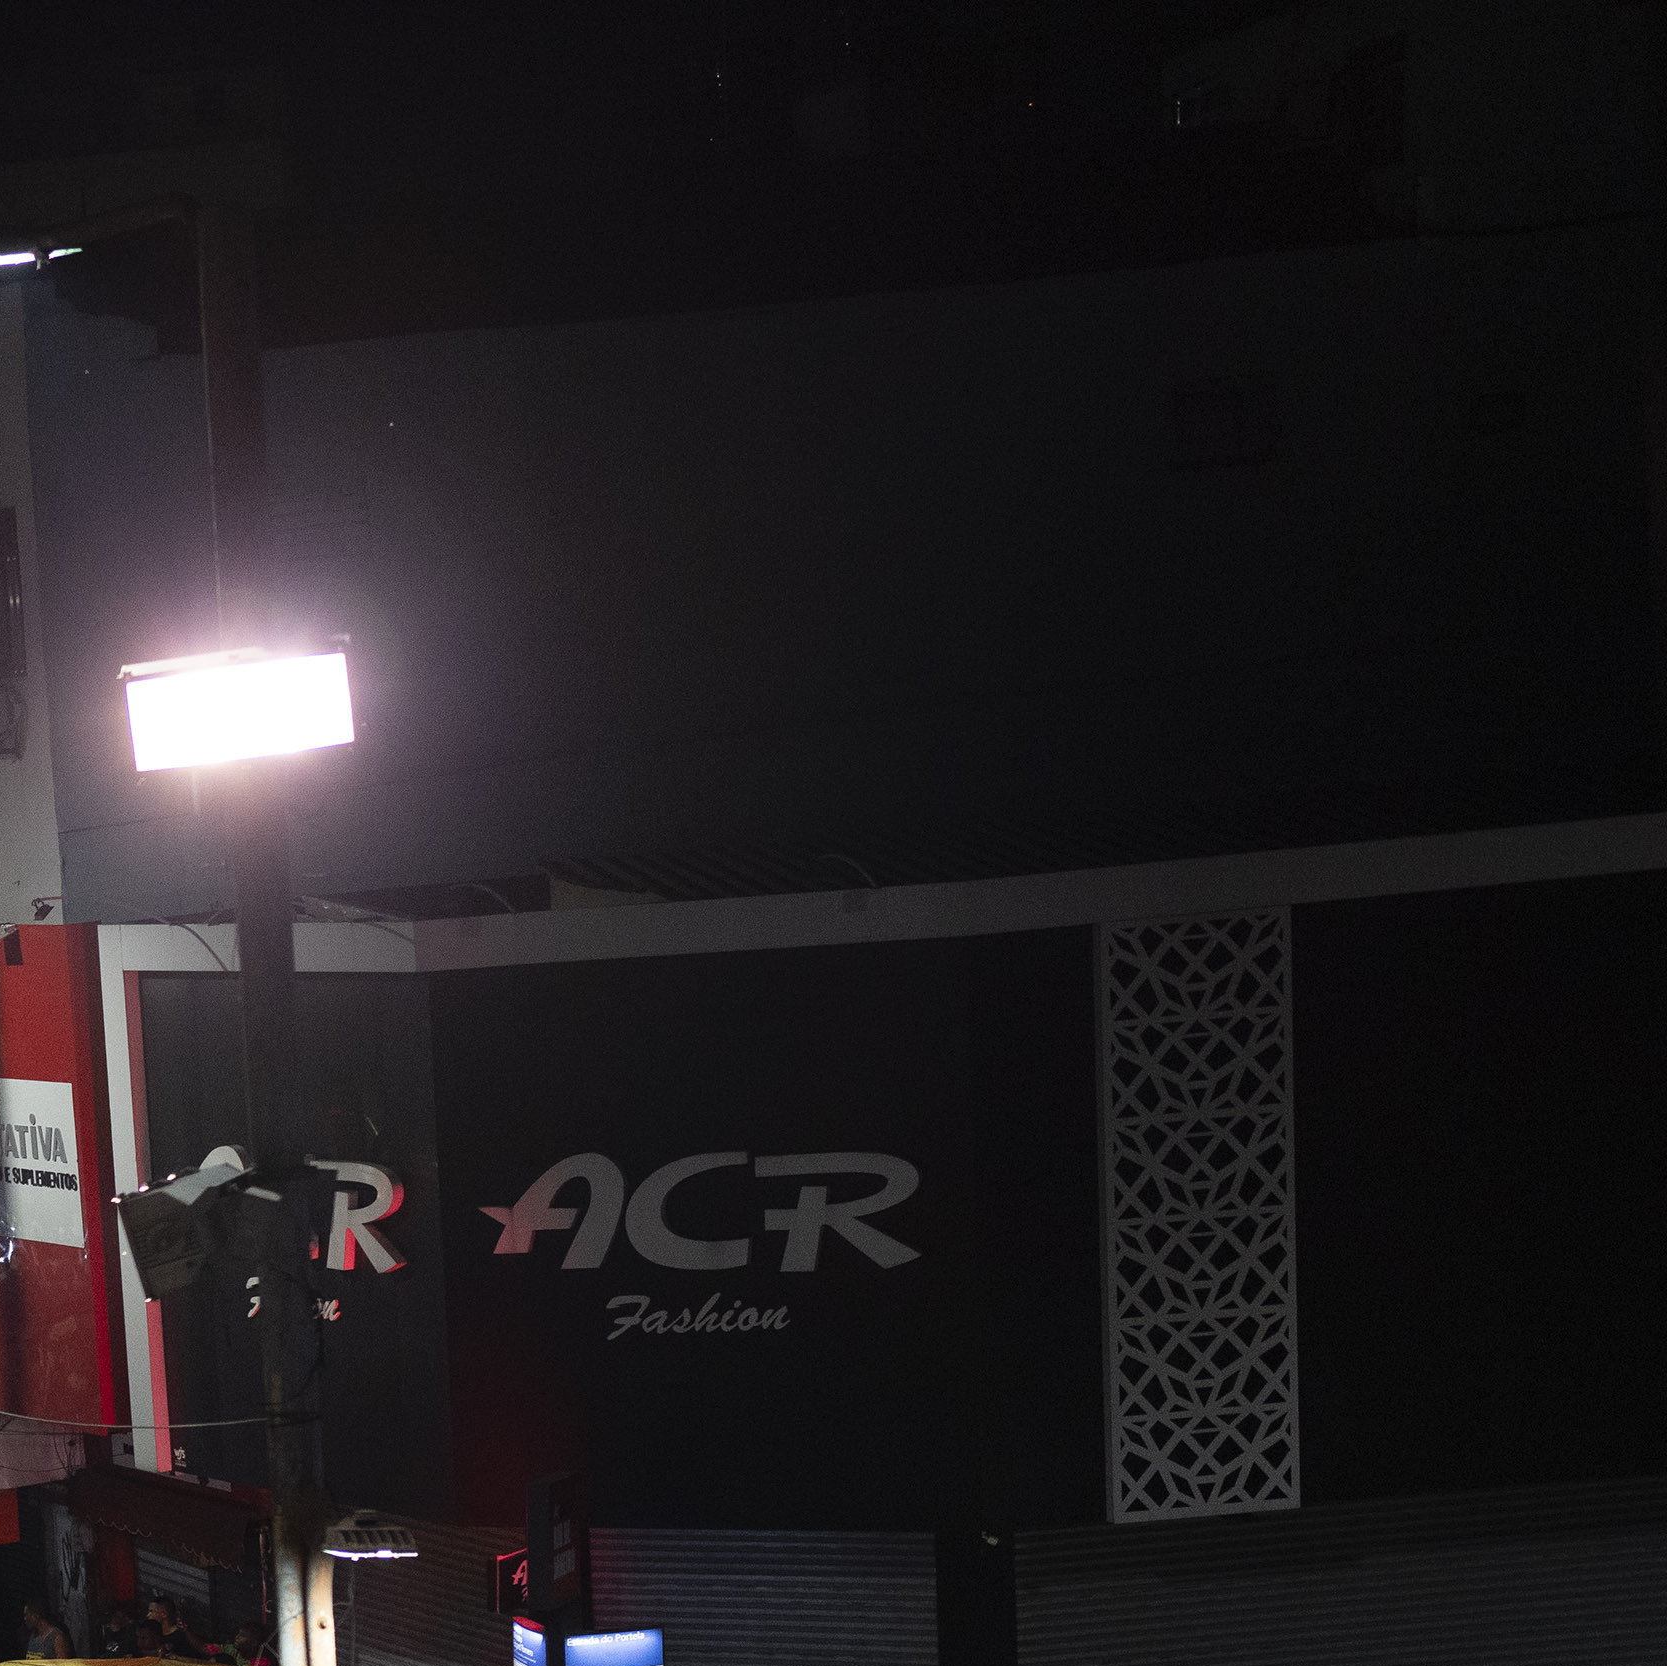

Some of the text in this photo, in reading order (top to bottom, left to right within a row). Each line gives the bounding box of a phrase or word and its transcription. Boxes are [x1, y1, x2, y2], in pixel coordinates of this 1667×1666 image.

[5, 1166, 11, 1184] E
[12, 1166, 79, 1192] SUPLEMENTOS
[478, 1152, 923, 1274] ACR
[605, 1292, 792, 1342] Fashion
[567, 1631, 645, 1648] Estrada do Portela
